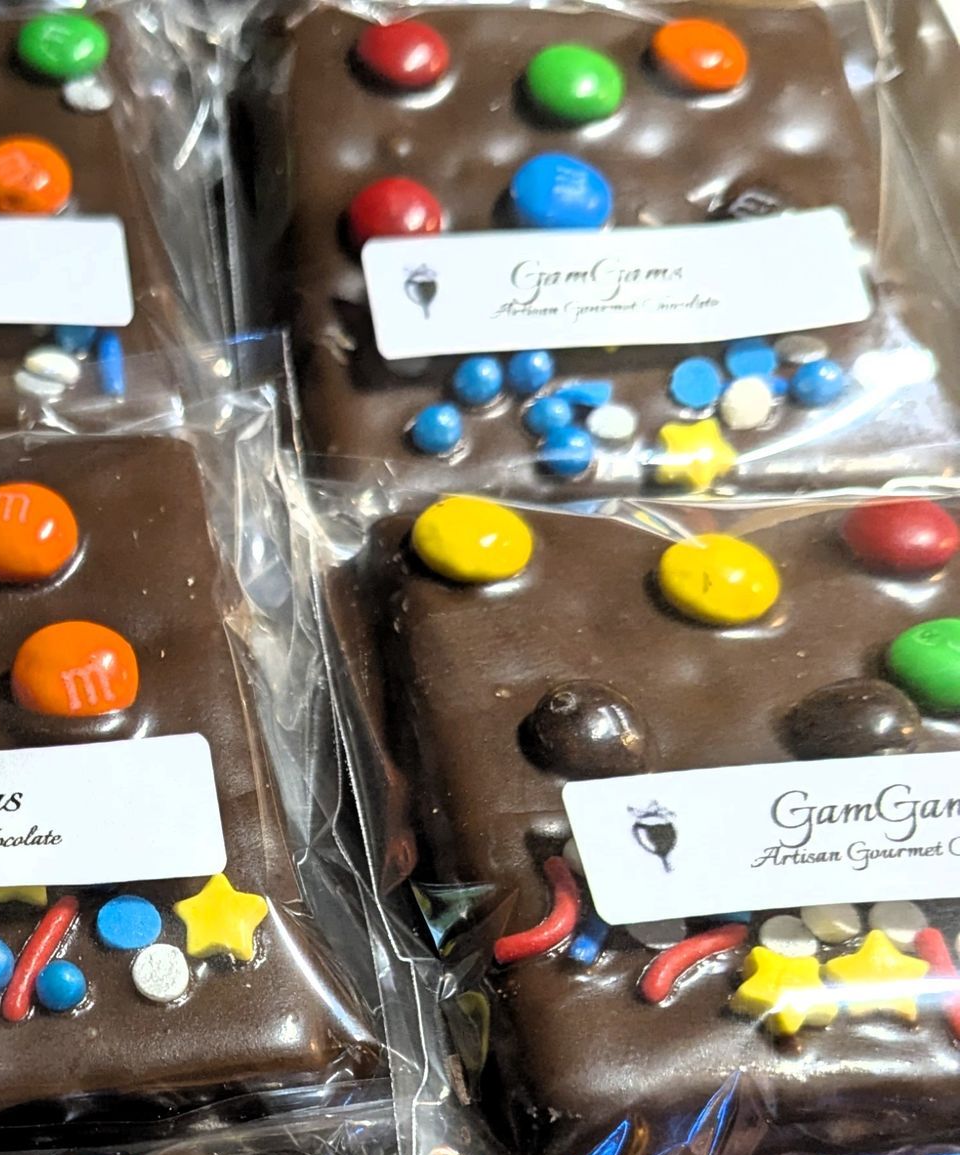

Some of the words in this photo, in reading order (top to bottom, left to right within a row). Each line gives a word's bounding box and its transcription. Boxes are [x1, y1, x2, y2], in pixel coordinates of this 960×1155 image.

[770, 783, 960, 849] GamGa
[750, 844, 843, 869] Artisan
[846, 840, 945, 872] Gourmet
